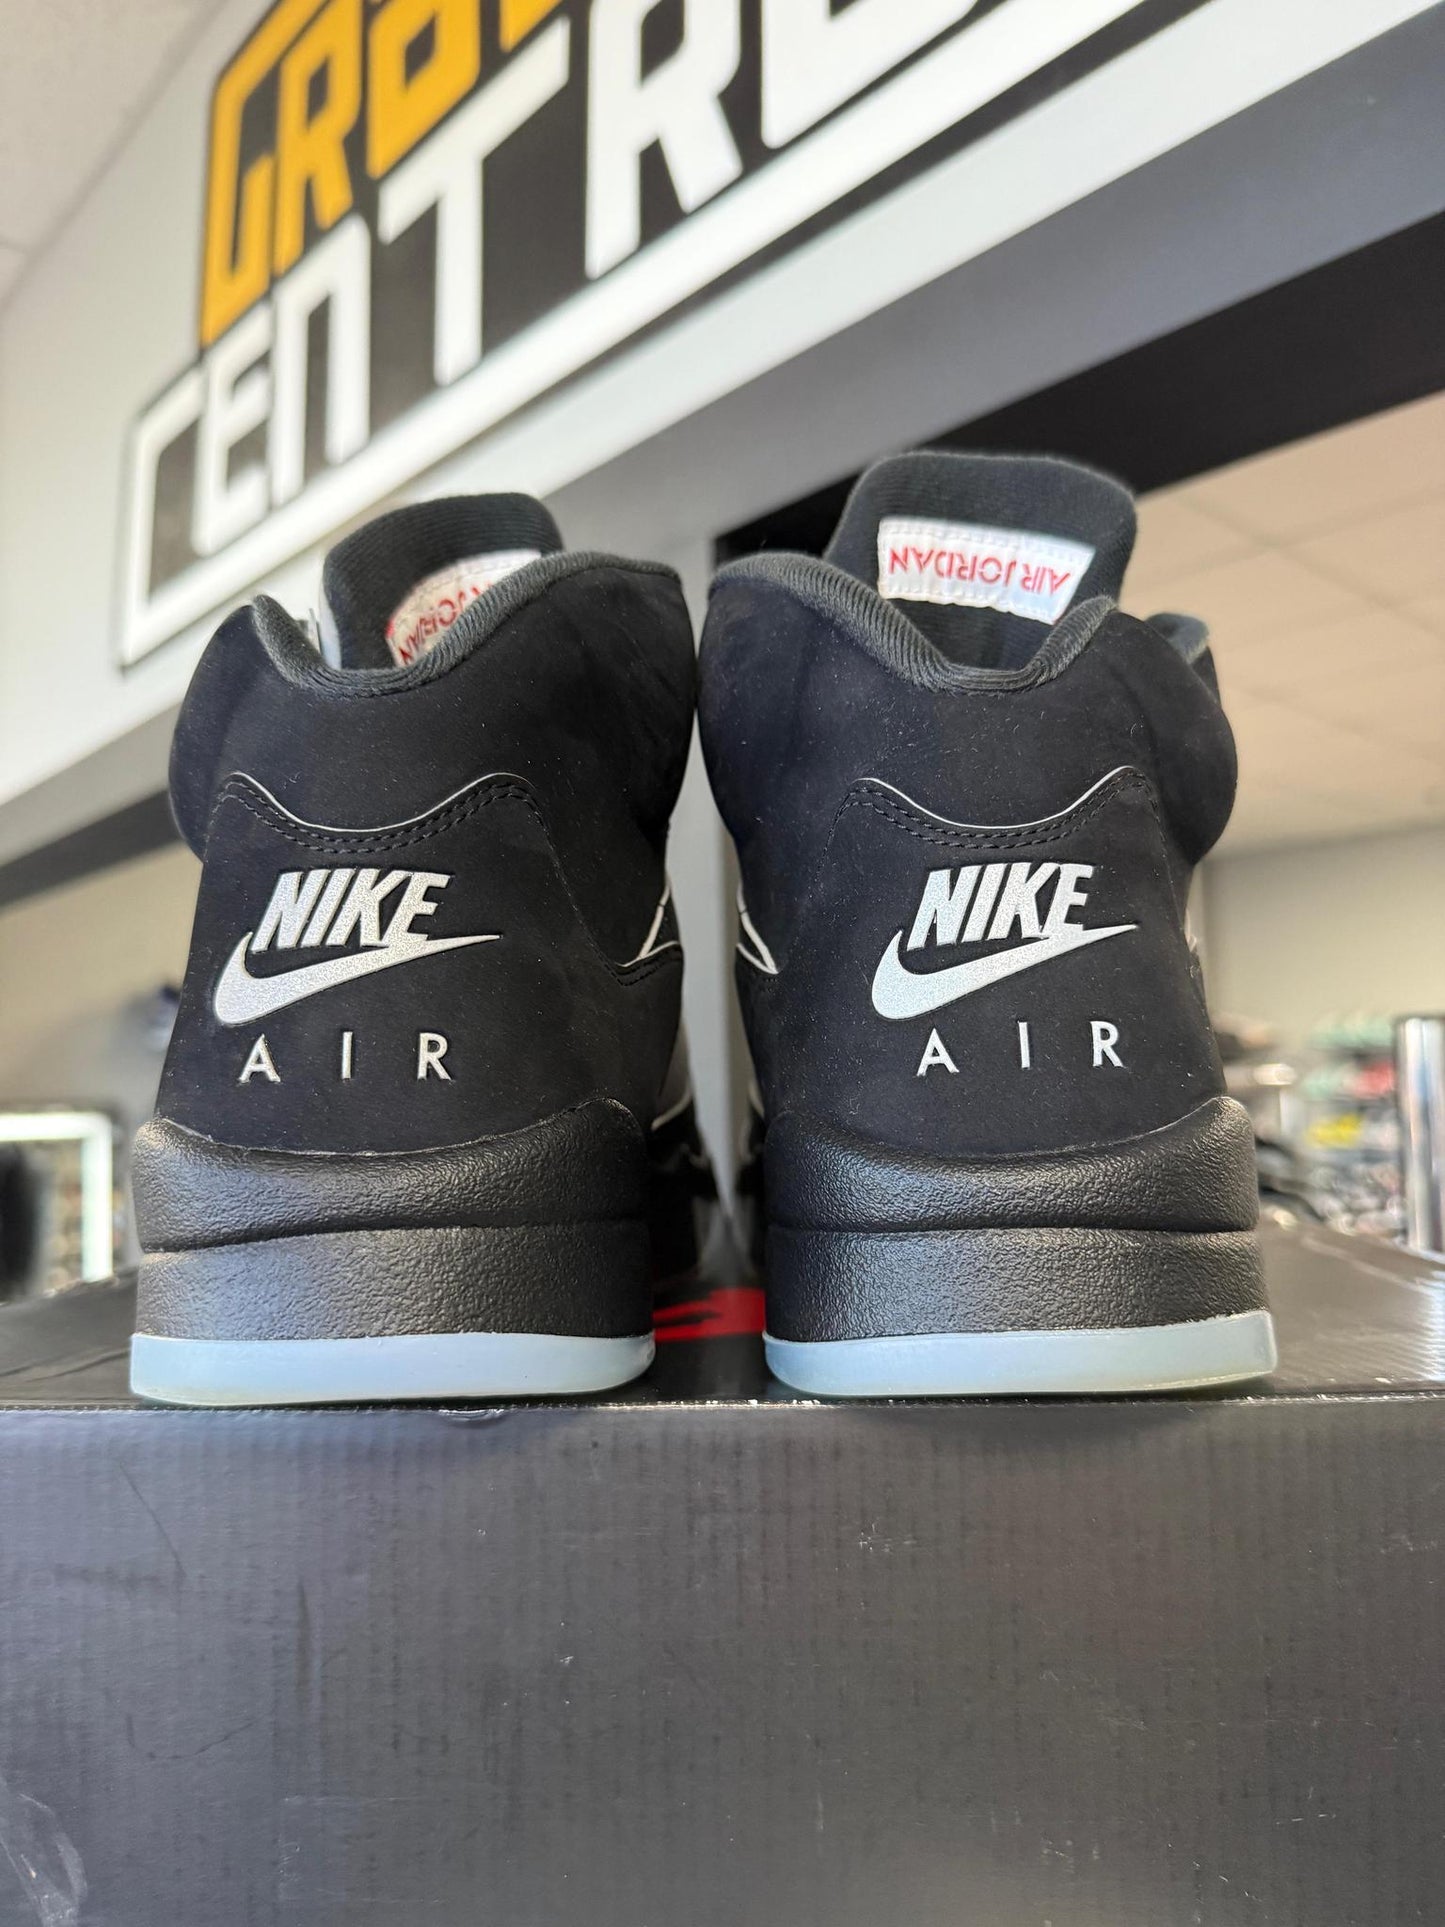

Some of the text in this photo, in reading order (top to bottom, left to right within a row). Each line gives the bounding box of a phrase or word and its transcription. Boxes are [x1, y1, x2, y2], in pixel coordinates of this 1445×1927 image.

[889, 547, 1072, 595] AIR JORDAN
[251, 867, 451, 954] NIKE
[907, 861, 1095, 952] NIKE
[238, 1030, 454, 1083] AIR
[916, 1020, 1126, 1077] AIR
